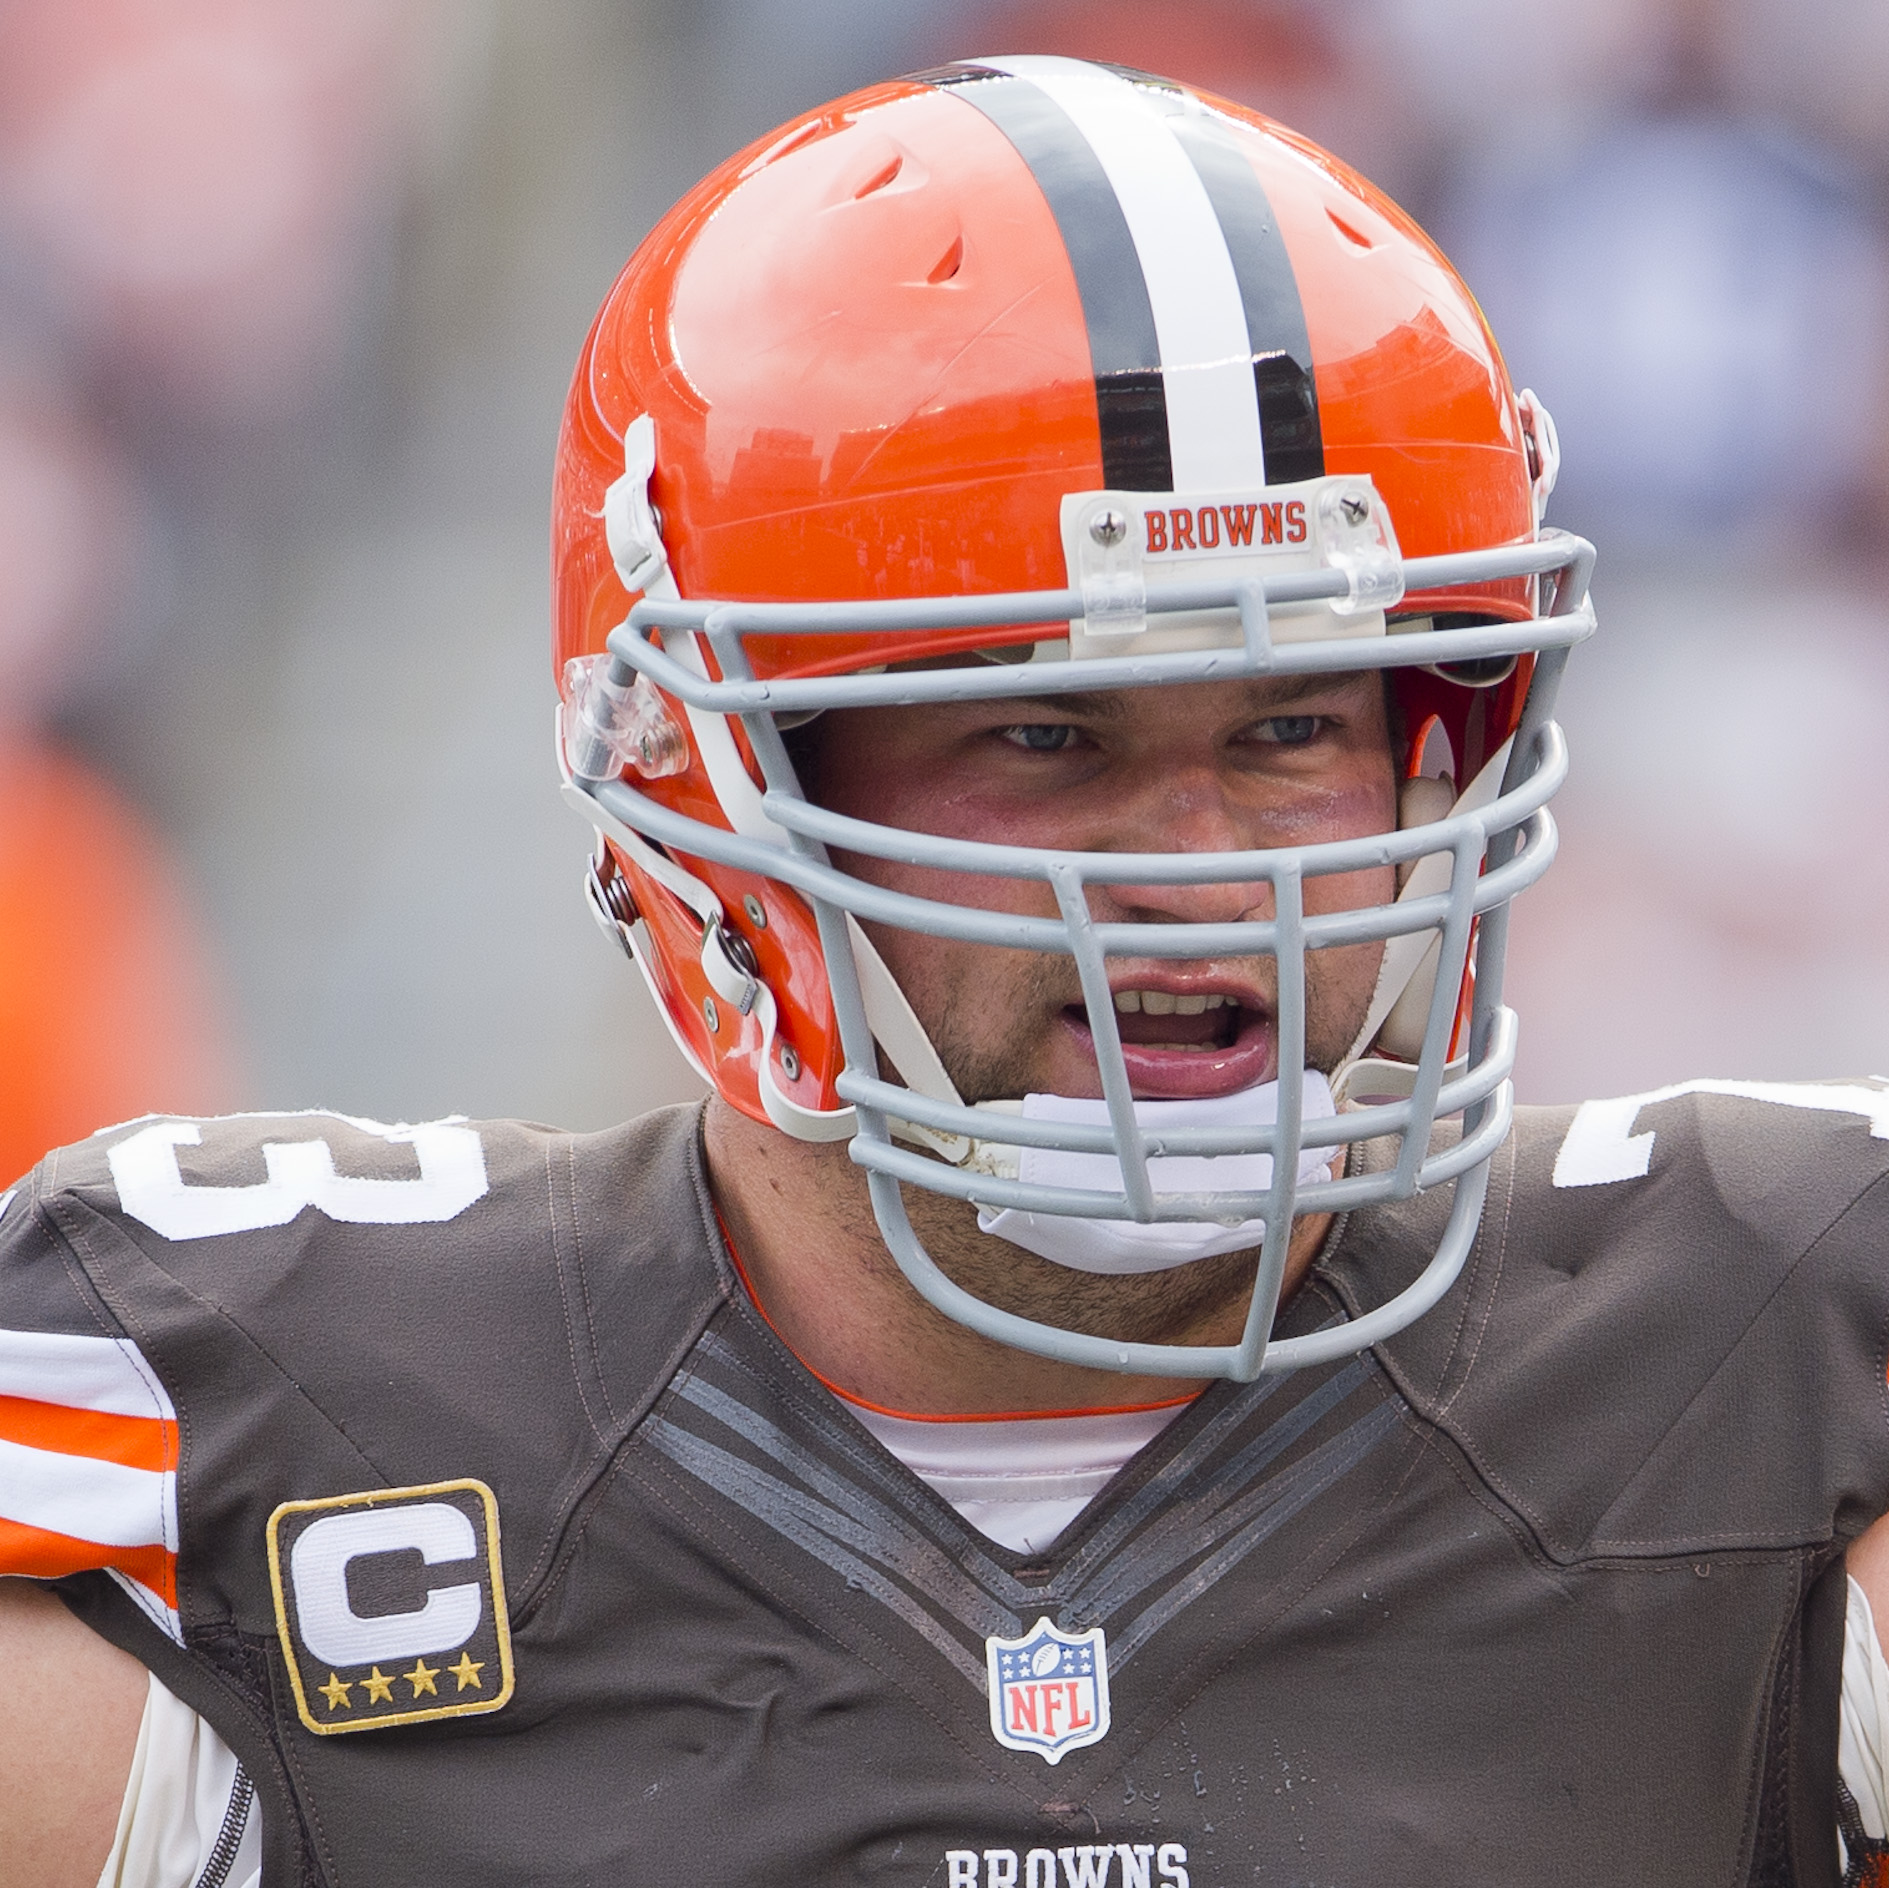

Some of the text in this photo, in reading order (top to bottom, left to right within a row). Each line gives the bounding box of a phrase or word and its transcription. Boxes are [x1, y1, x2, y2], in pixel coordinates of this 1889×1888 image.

[1144, 501, 1307, 553] BROWNS
[291, 1502, 482, 1668] C
[1009, 1682, 1091, 1737] NFL
